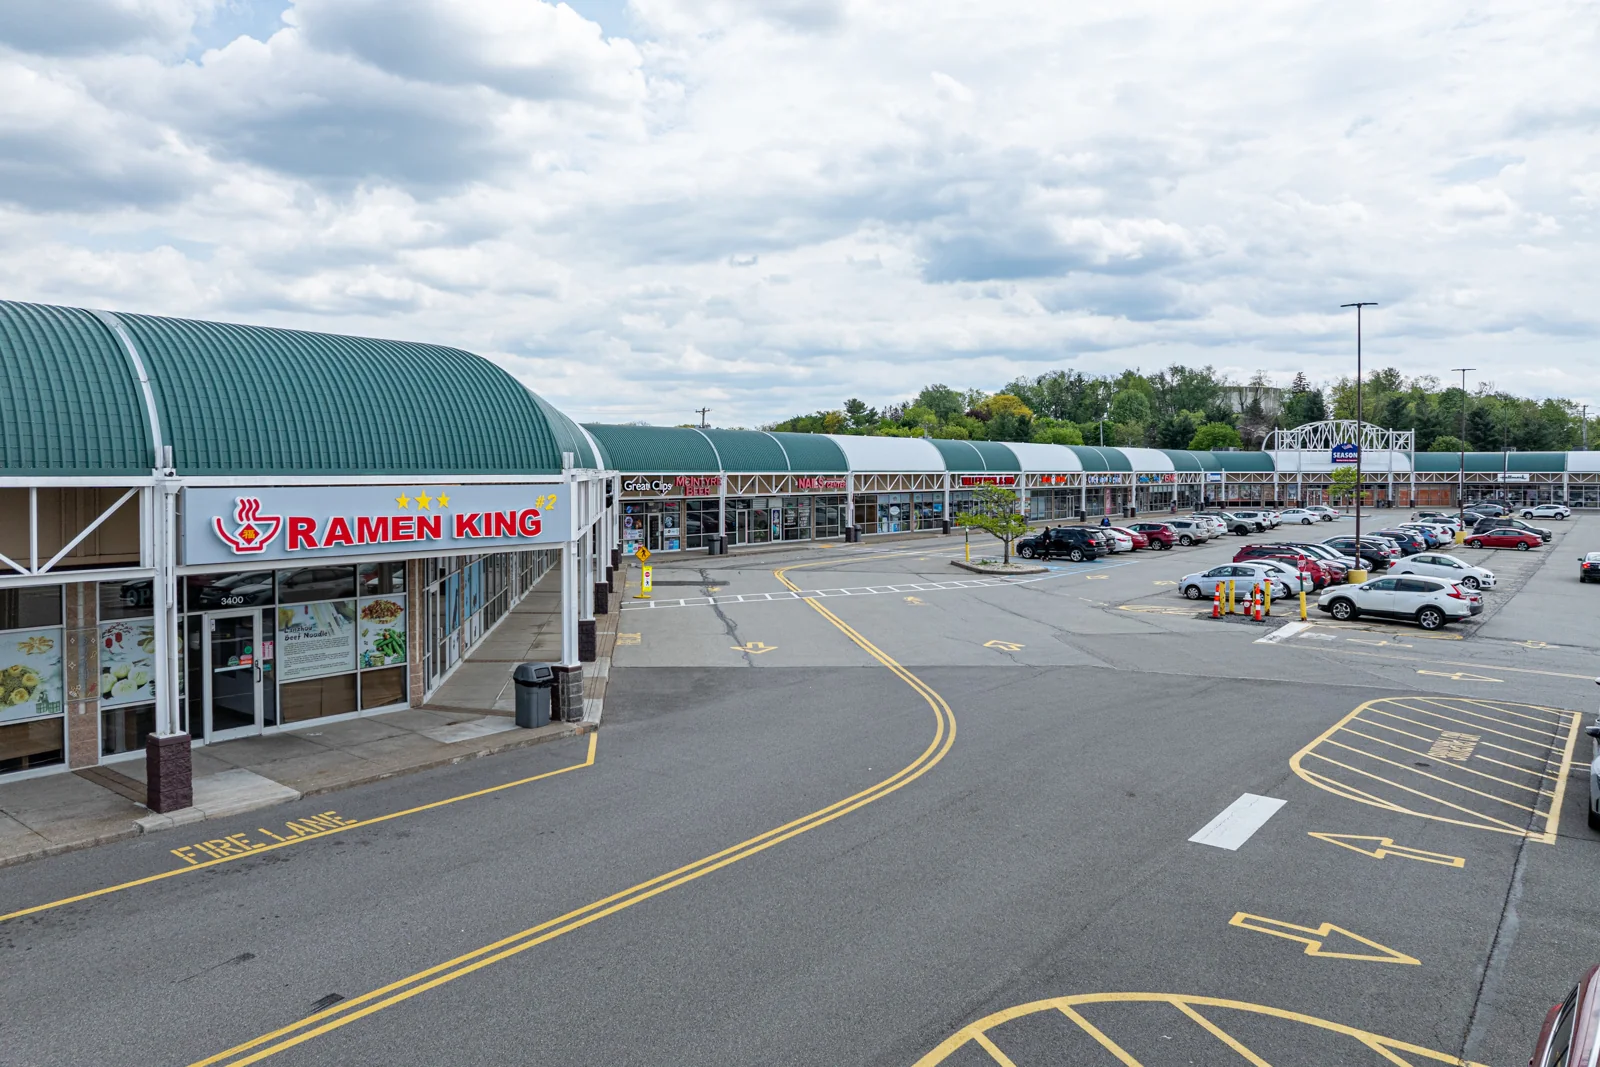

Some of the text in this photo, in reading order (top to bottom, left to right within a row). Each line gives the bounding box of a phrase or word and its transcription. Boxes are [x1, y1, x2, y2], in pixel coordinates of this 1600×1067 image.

[624, 480, 650, 491] Great
[798, 478, 824, 488] NAILS
[685, 486, 711, 496] BEER
[286, 493, 557, 550] RAMEN KING #2
[221, 596, 244, 605] 3400
[304, 630, 328, 639] Noodle
[170, 811, 357, 865] FIRE LANE
